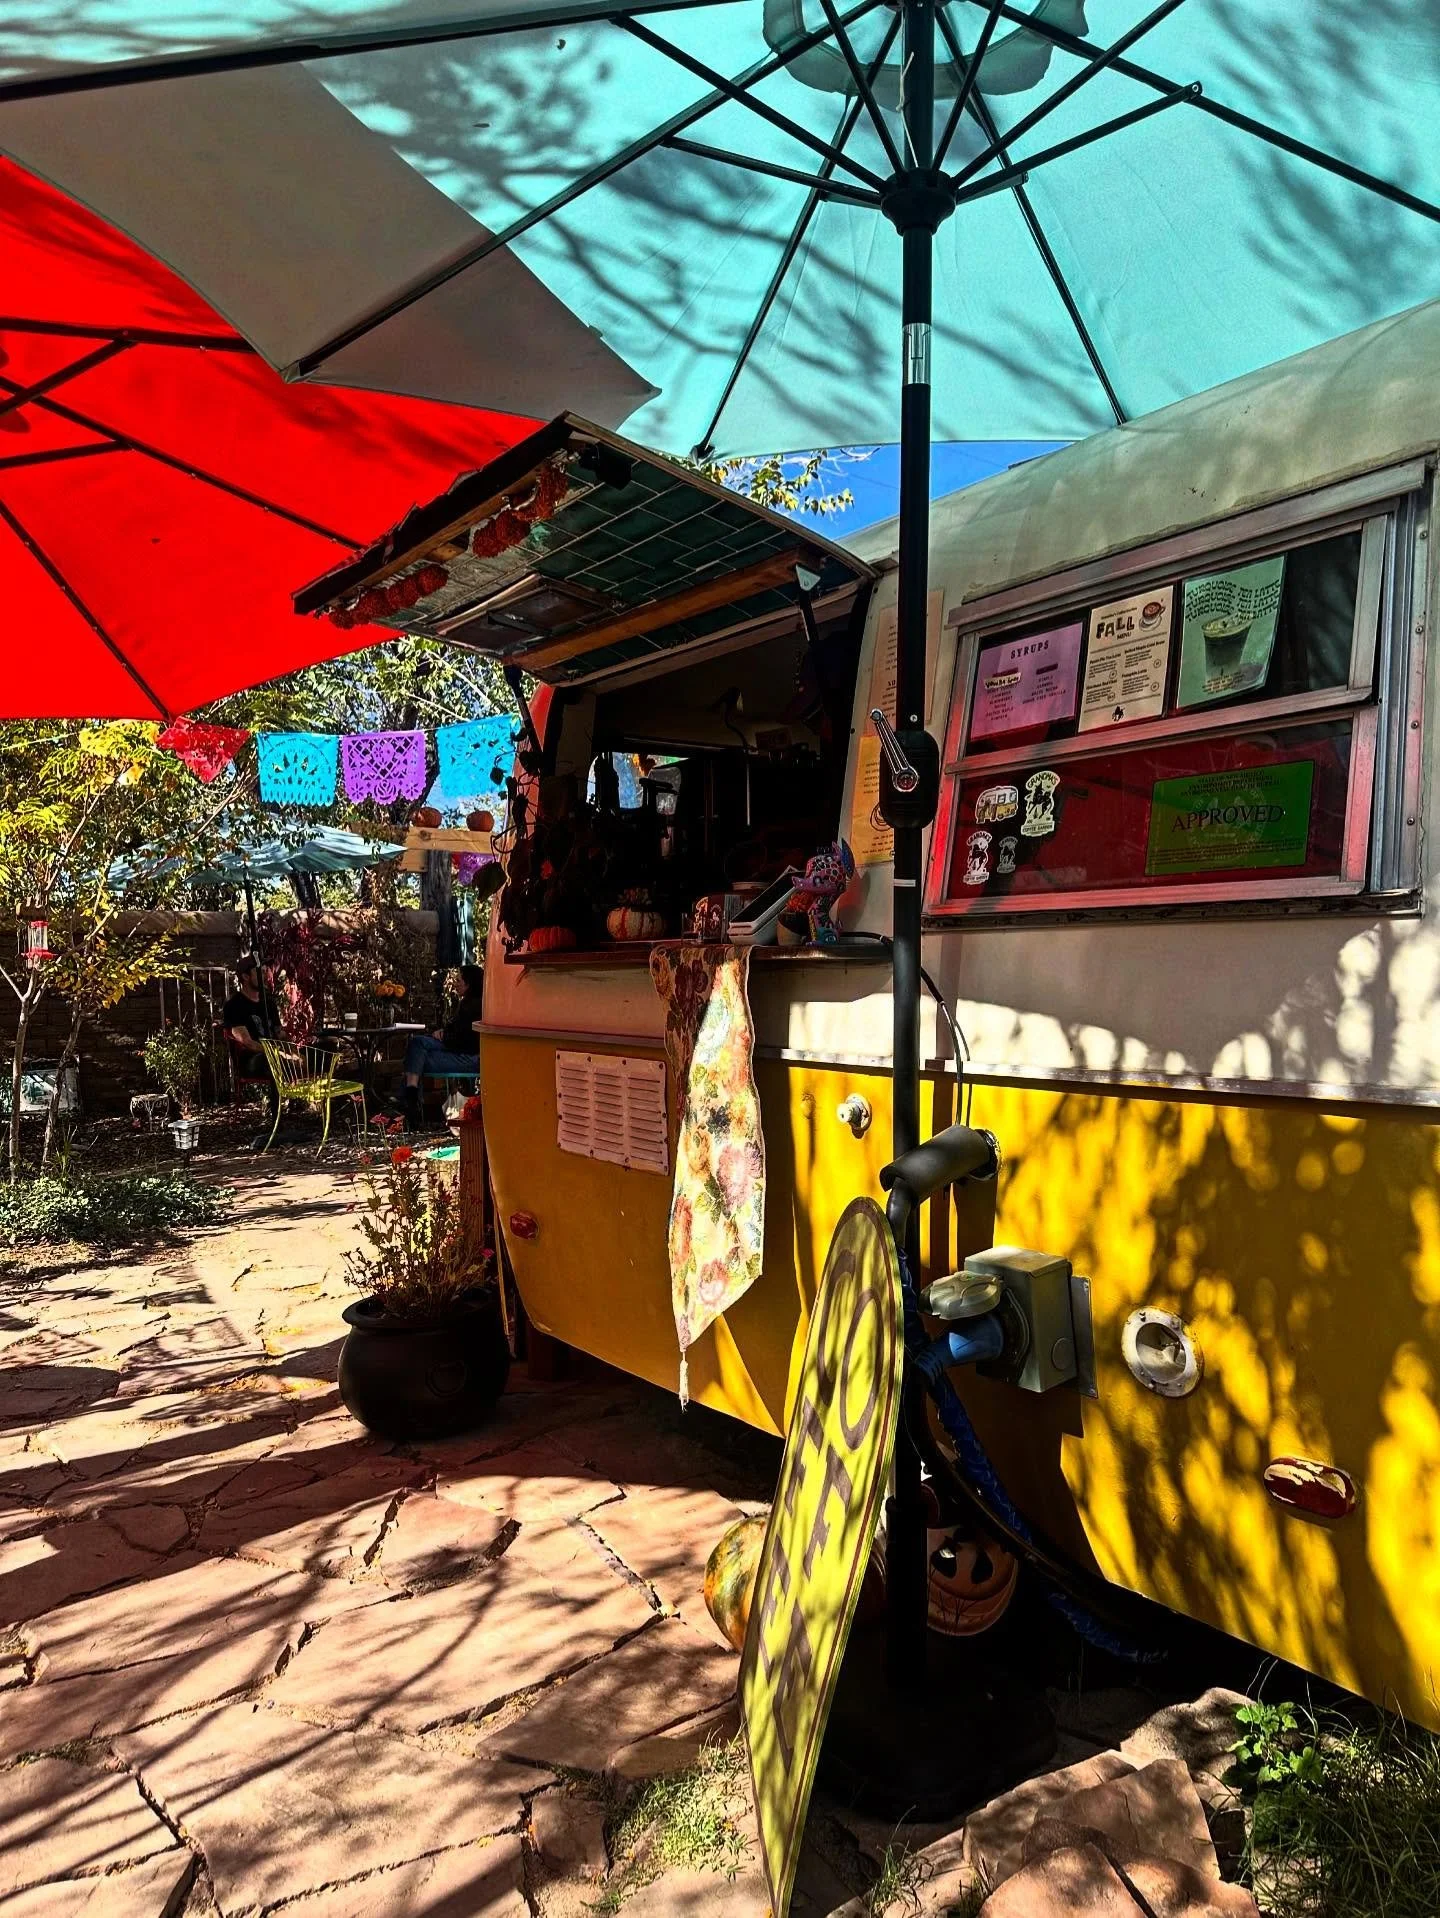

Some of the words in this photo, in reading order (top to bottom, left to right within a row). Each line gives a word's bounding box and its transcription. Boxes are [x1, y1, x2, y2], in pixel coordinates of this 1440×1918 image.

[1186, 581, 1237, 600] TURQUOISE
[1186, 592, 1236, 612] TURQUOISE
[1096, 616, 1135, 640] FALL
[1117, 632, 1132, 640] MENU
[1010, 640, 1050, 660] SYRUPS
[1172, 804, 1285, 832] APPROVED
[758, 1249, 885, 1776] COFFEE
